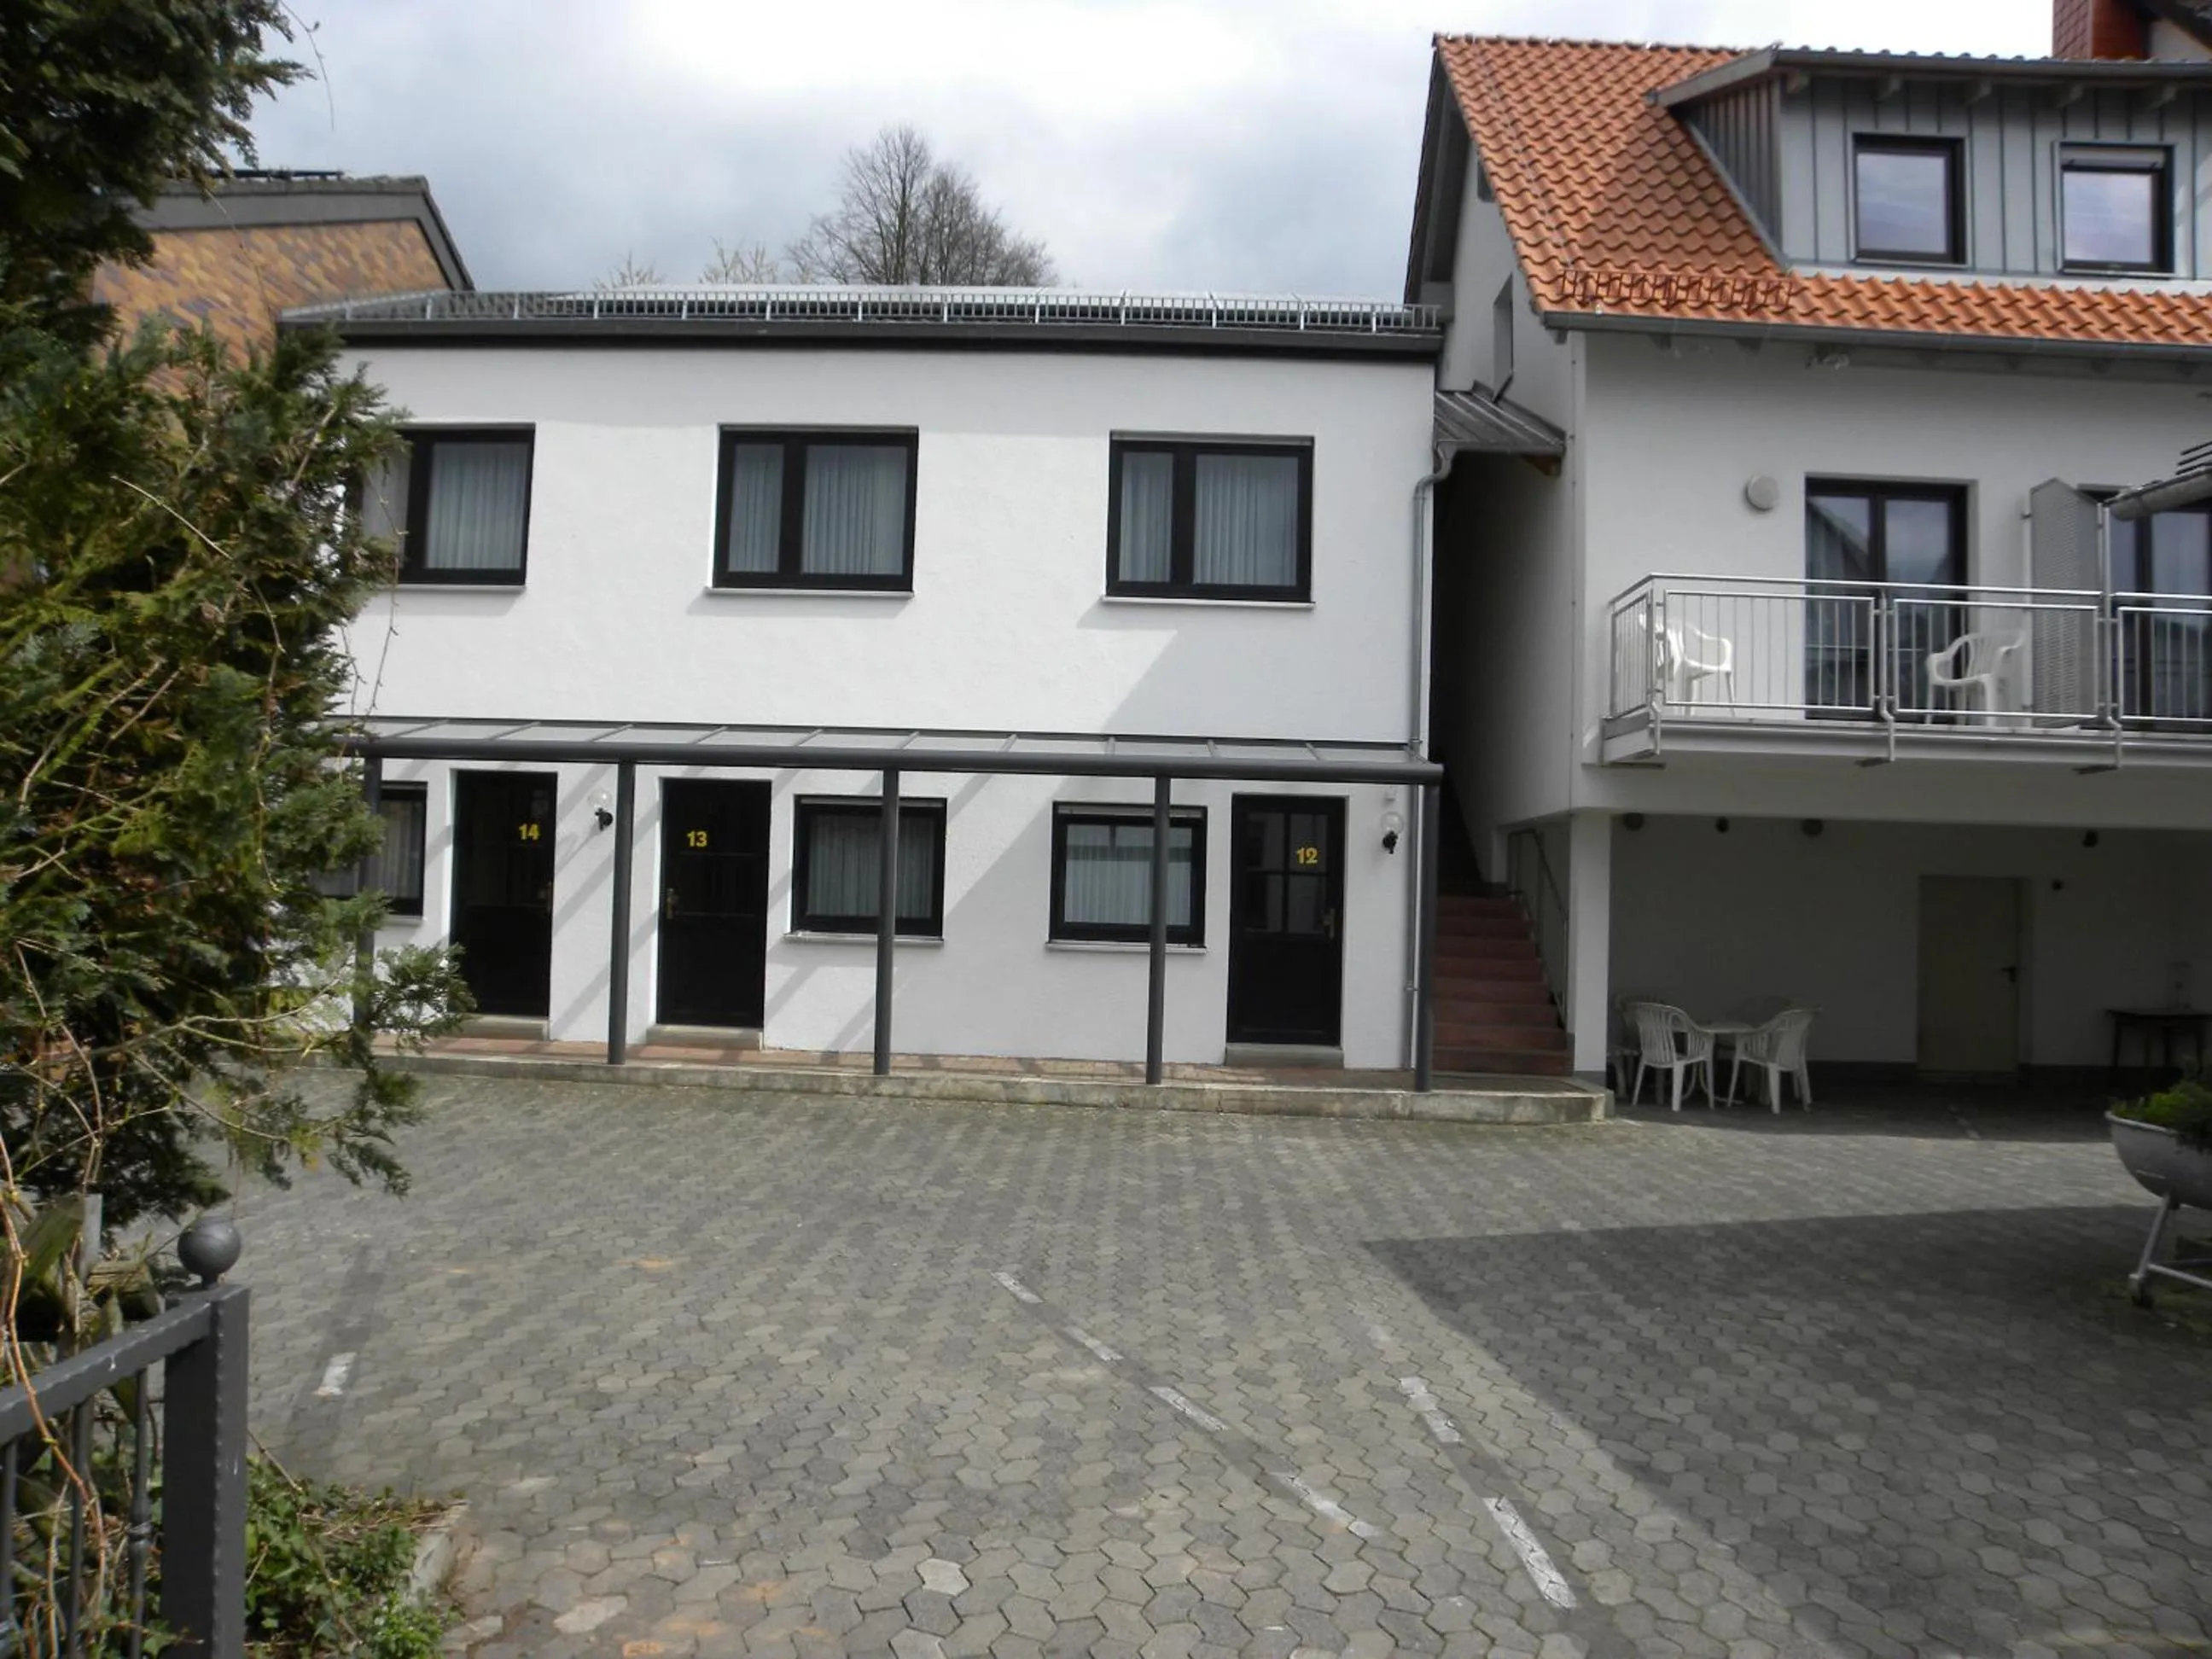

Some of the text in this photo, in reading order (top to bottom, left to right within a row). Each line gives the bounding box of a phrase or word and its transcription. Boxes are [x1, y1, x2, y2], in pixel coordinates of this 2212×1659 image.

[519, 824, 539, 840] 14
[687, 830, 707, 847] 13
[1296, 847, 1318, 864] 12
